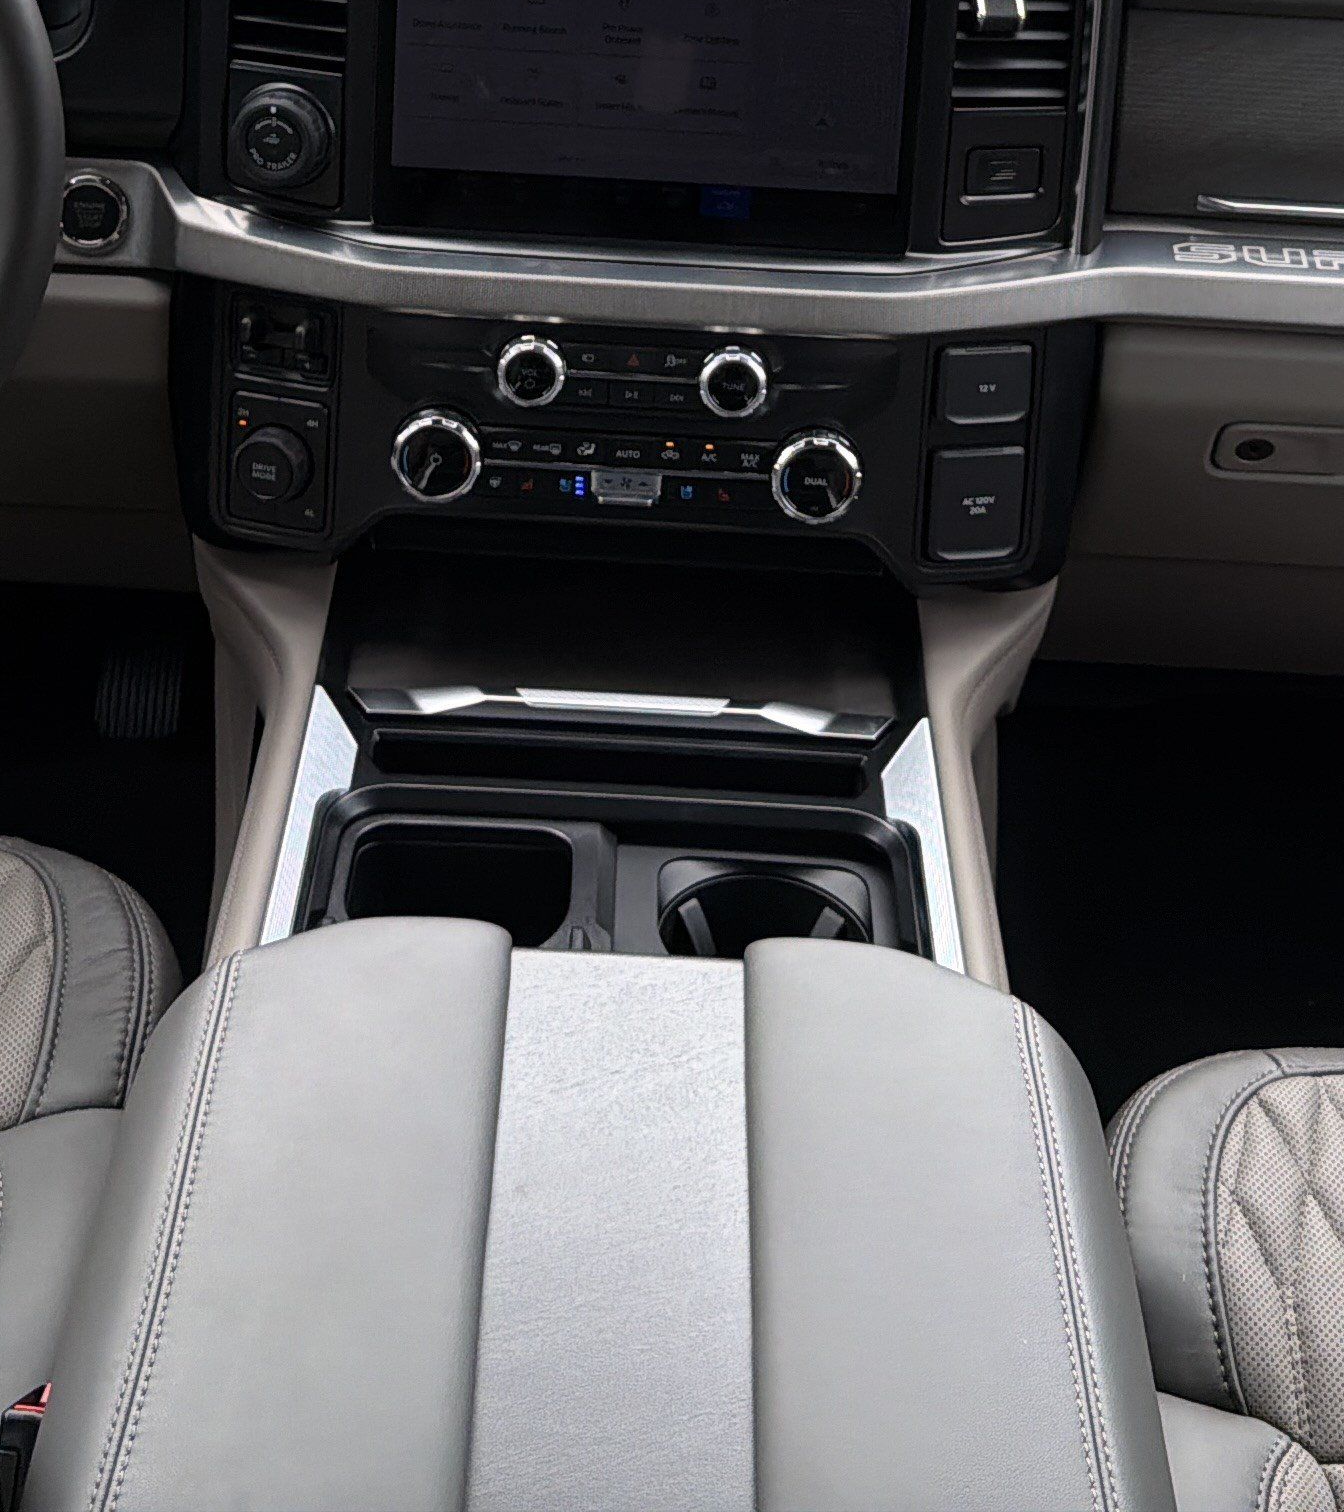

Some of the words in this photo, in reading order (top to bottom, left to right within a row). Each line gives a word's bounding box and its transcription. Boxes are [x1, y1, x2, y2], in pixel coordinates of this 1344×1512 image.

[615, 449, 641, 460] AUTO
[252, 461, 277, 472] DRIVE
[251, 471, 277, 482] MODE
[803, 476, 828, 487] DUAL
[961, 496, 974, 506] AC
[975, 494, 996, 506] 120V
